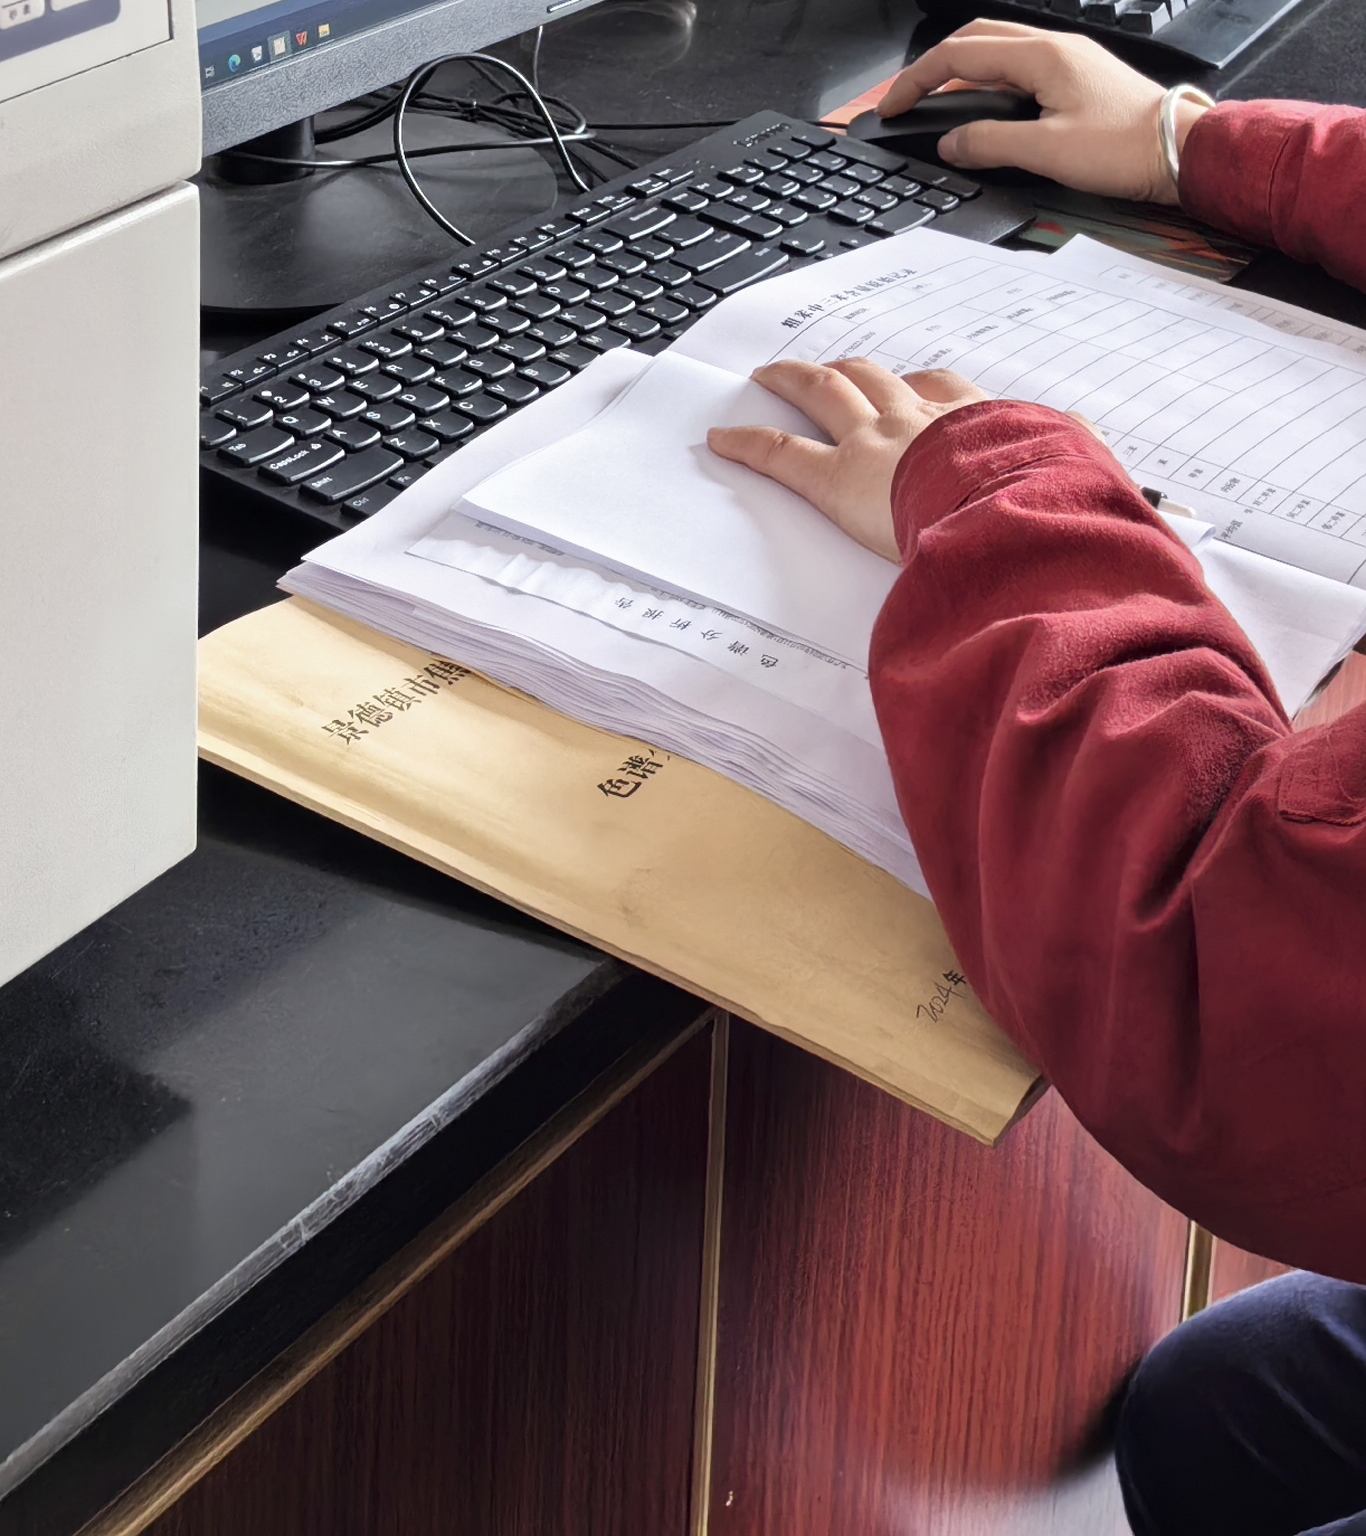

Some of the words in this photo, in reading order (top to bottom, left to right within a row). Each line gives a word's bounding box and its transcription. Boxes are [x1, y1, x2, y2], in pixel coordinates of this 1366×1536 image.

[562, 311, 577, 321] K
[452, 331, 466, 341] Y
[419, 346, 435, 356] T
[499, 342, 515, 353] H
[468, 358, 484, 367] G
[386, 363, 404, 373] R
[524, 367, 538, 377] B
[353, 380, 369, 390] E
[435, 375, 450, 386] F
[491, 384, 505, 393] V
[273, 395, 288, 404] 2
[317, 395, 335, 407] W
[401, 393, 417, 402] D
[459, 401, 475, 410] C
[281, 415, 299, 424] Q
[366, 410, 382, 420] S
[424, 418, 441, 428] X
[332, 428, 348, 439] A
[228, 441, 247, 452] Tab
[390, 437, 406, 448] Z
[351, 496, 370, 508] Ctrl
[612, 594, 781, 670] 色谱分析报告
[596, 748, 672, 799] 色谱
